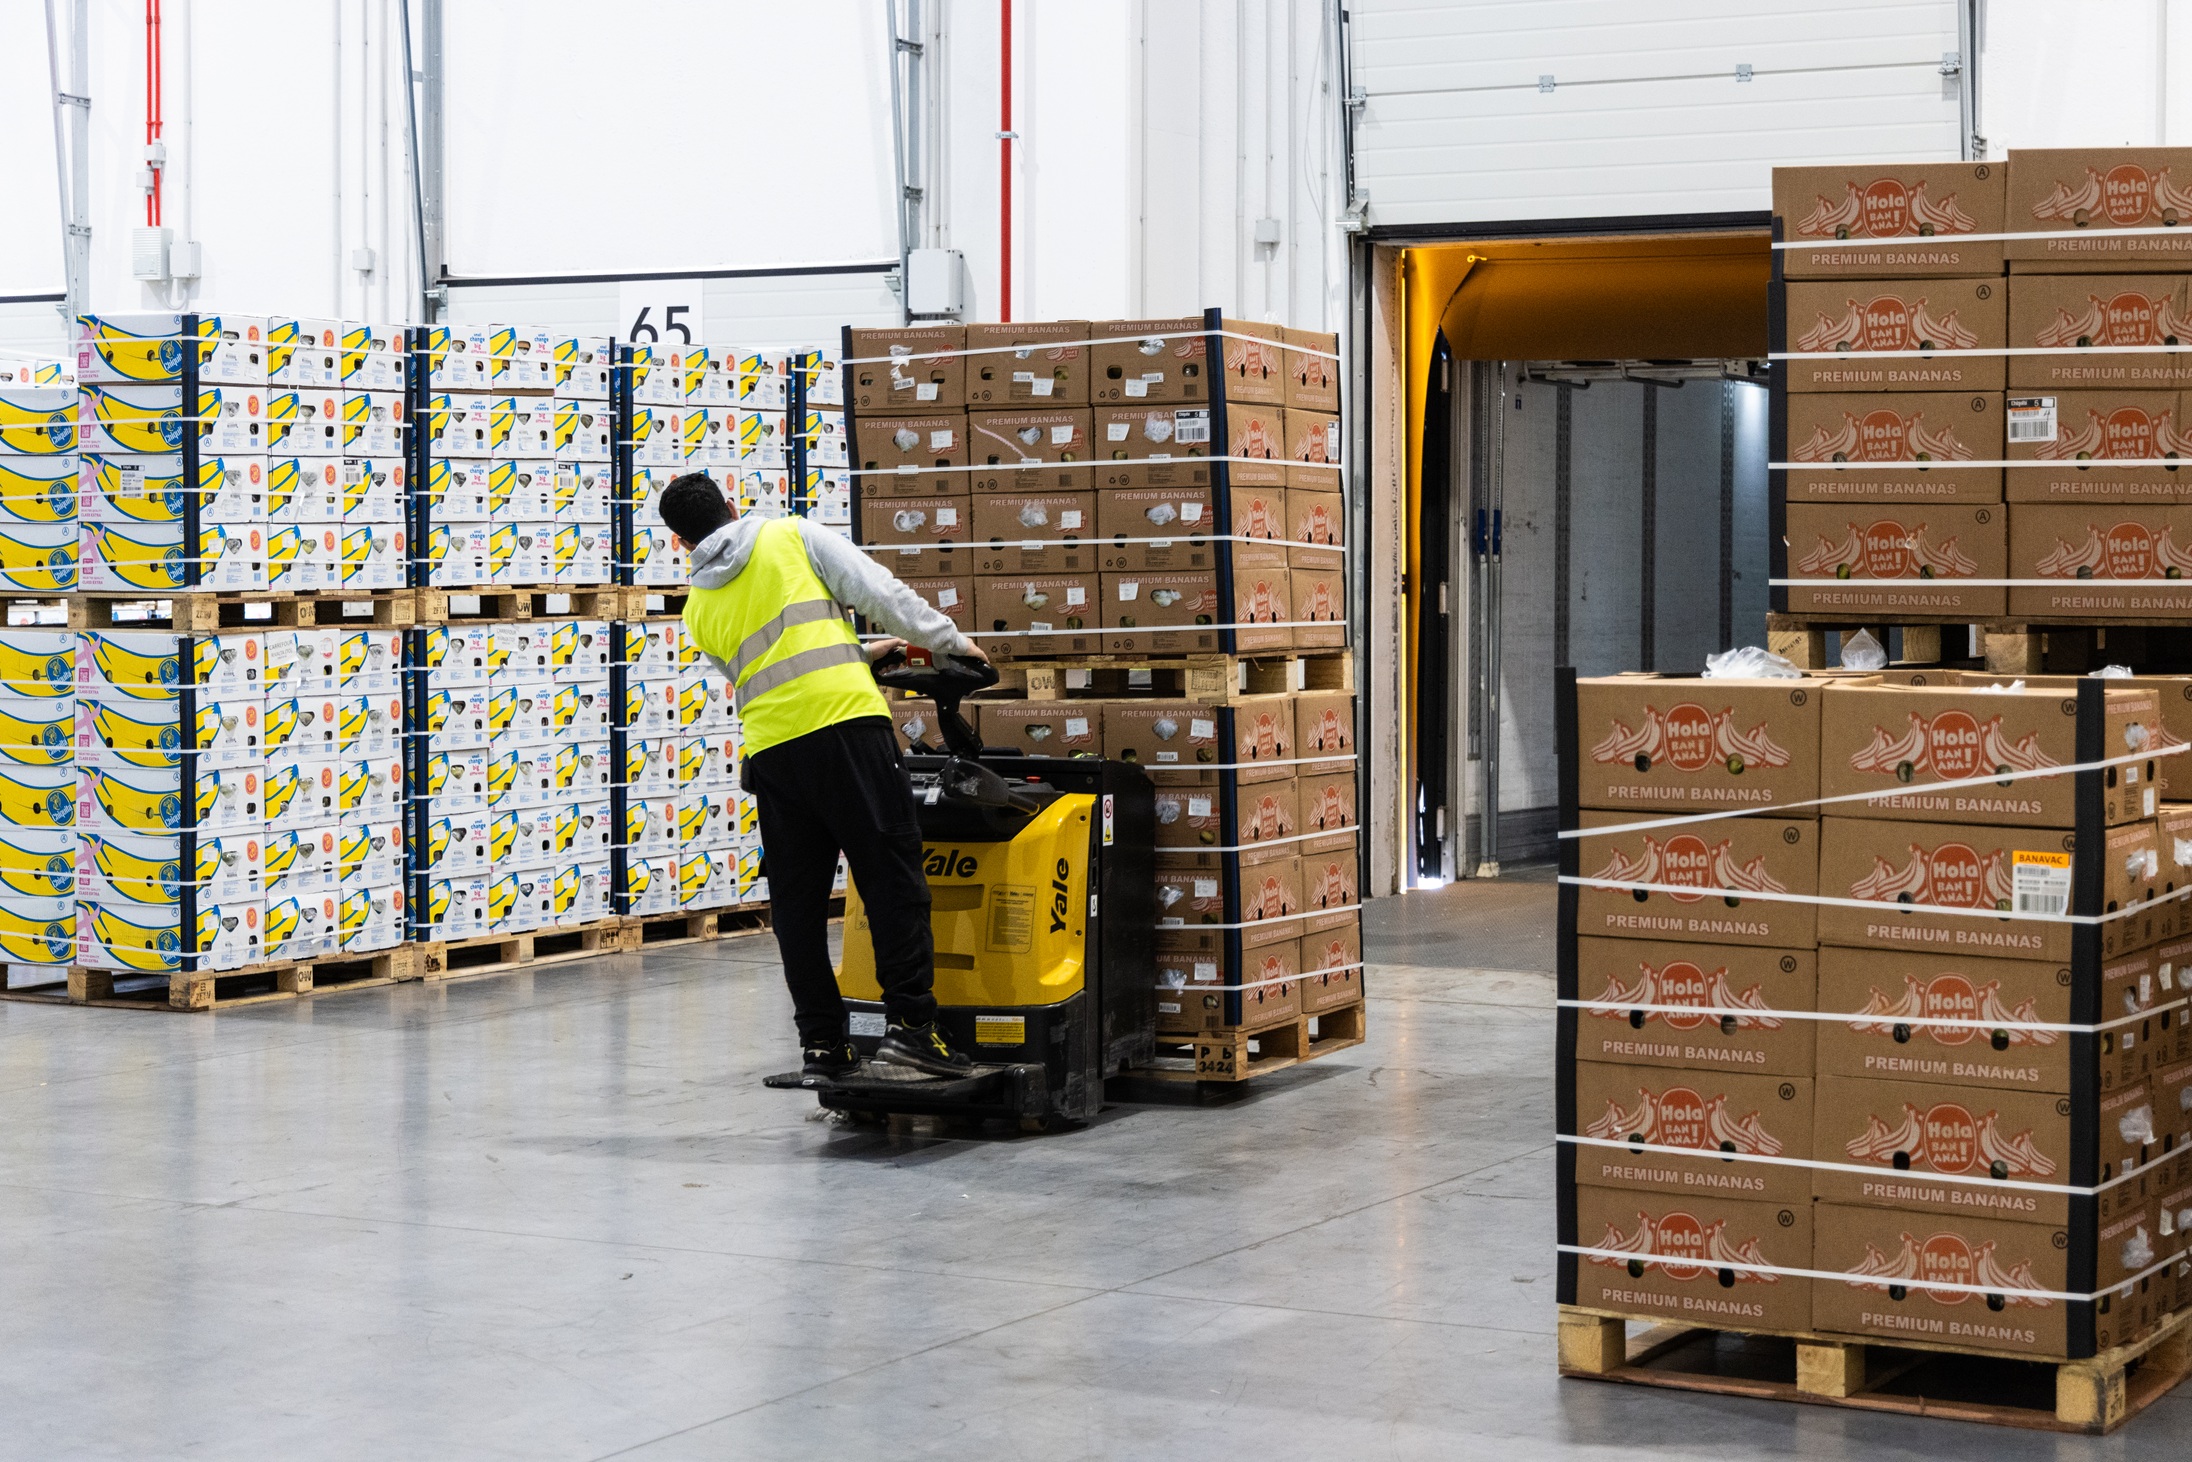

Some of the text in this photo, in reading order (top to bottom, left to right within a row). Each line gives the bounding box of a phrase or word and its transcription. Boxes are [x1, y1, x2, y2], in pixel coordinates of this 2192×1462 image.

[2107, 179, 2147, 195] Hola
[1866, 193, 1904, 210] Hola
[2110, 197, 2133, 206] BAN
[1870, 212, 1892, 222] BAN
[2048, 240, 2120, 250] PREMIUM
[1812, 253, 1960, 265] PREMIUM BANANAS
[1867, 311, 1905, 328] Hola
[2109, 307, 2150, 324] Hola
[630, 306, 691, 345] 65
[1027, 326, 1070, 334] BANANAS
[1109, 322, 1198, 332] PREMIUM BANANAS
[2113, 325, 2136, 334] BAN
[861, 332, 900, 340] PREMIUM
[1871, 328, 1893, 338] BAN
[1813, 370, 1962, 382] PREMIUM BANANAS
[2051, 368, 2125, 378] PREMIUM
[908, 420, 950, 428] BANANAS
[987, 416, 1074, 425] PREMIUM BANANAS
[1863, 424, 1902, 440] Hola
[2109, 422, 2149, 438] Hola
[1867, 442, 1888, 450] BAN
[2113, 441, 2135, 449] BAN
[1809, 483, 1956, 494] PREMIUM BANANAS
[2051, 483, 2124, 493] PREMIUM
[1161, 491, 1205, 499] BANANAS
[911, 500, 953, 508] BANANAS
[1867, 535, 1906, 551] Hola
[2109, 537, 2150, 553] Hola
[1871, 553, 1892, 562] BAN
[2113, 555, 2135, 564] BAN
[913, 581, 955, 589] BANANAS
[1036, 580, 1079, 588] BANANAS
[1165, 576, 1209, 584] BANANAS
[1813, 593, 1961, 606] PREMIUM BANANAS
[2052, 597, 2124, 608] PREMIUM
[997, 708, 1084, 717] PREMIUM BANANAS
[1121, 710, 1210, 718] PREMIUM BANANAS
[1667, 720, 1710, 738] Hola
[1932, 728, 1977, 746] Hola
[1672, 740, 1695, 751] BAN
[1936, 749, 1961, 759] BAN
[1608, 786, 1773, 801] PREMIUM BANANAS
[1867, 795, 2042, 814] PREMIUM BANANAS
[51, 805, 73, 821] Chiquita
[1665, 852, 1707, 868] Hola
[2019, 854, 2063, 865] BANAVAC
[1933, 861, 1978, 878] Hola
[1170, 875, 1215, 883] BANANAS
[1670, 871, 1693, 881] BAN
[1937, 881, 1963, 891] BAN
[1050, 858, 1069, 934] Yale
[1316, 916, 1335, 927] PREMIUM
[1606, 915, 1769, 935] PREMIUM BANANAS
[1251, 927, 1294, 942] PREMIUM BANANAS
[1867, 925, 2042, 949] PREMIUM BANANAS
[1173, 955, 1218, 963] BANANAS
[1662, 978, 1704, 995] Hola
[1317, 994, 1336, 1004] PREMIUM
[1928, 993, 1974, 1010] Hola
[1252, 1011, 1273, 1023] PREMIUM
[1201, 1047, 1210, 1058] P
[1603, 1040, 1766, 1064] PREMIUM BANANAS
[1199, 1063, 1233, 1074] 3424
[1865, 1056, 2039, 1082] PREMIUM BANANAS
[1661, 1104, 1703, 1121] Hola
[1666, 1124, 1688, 1135] BAN
[1927, 1122, 1973, 1139] Hola
[1932, 1142, 1958, 1151] BAN
[1602, 1165, 1765, 1191] PREMIUM BANANAS
[1863, 1183, 2036, 1211] PREMIUM BANANAS
[1660, 1229, 1702, 1246] Hola
[1924, 1252, 1969, 1270] Hola
[1602, 1288, 1763, 1318] PREMIUM BANANAS
[1861, 1312, 2035, 1344] PREMIUM BANANAS
